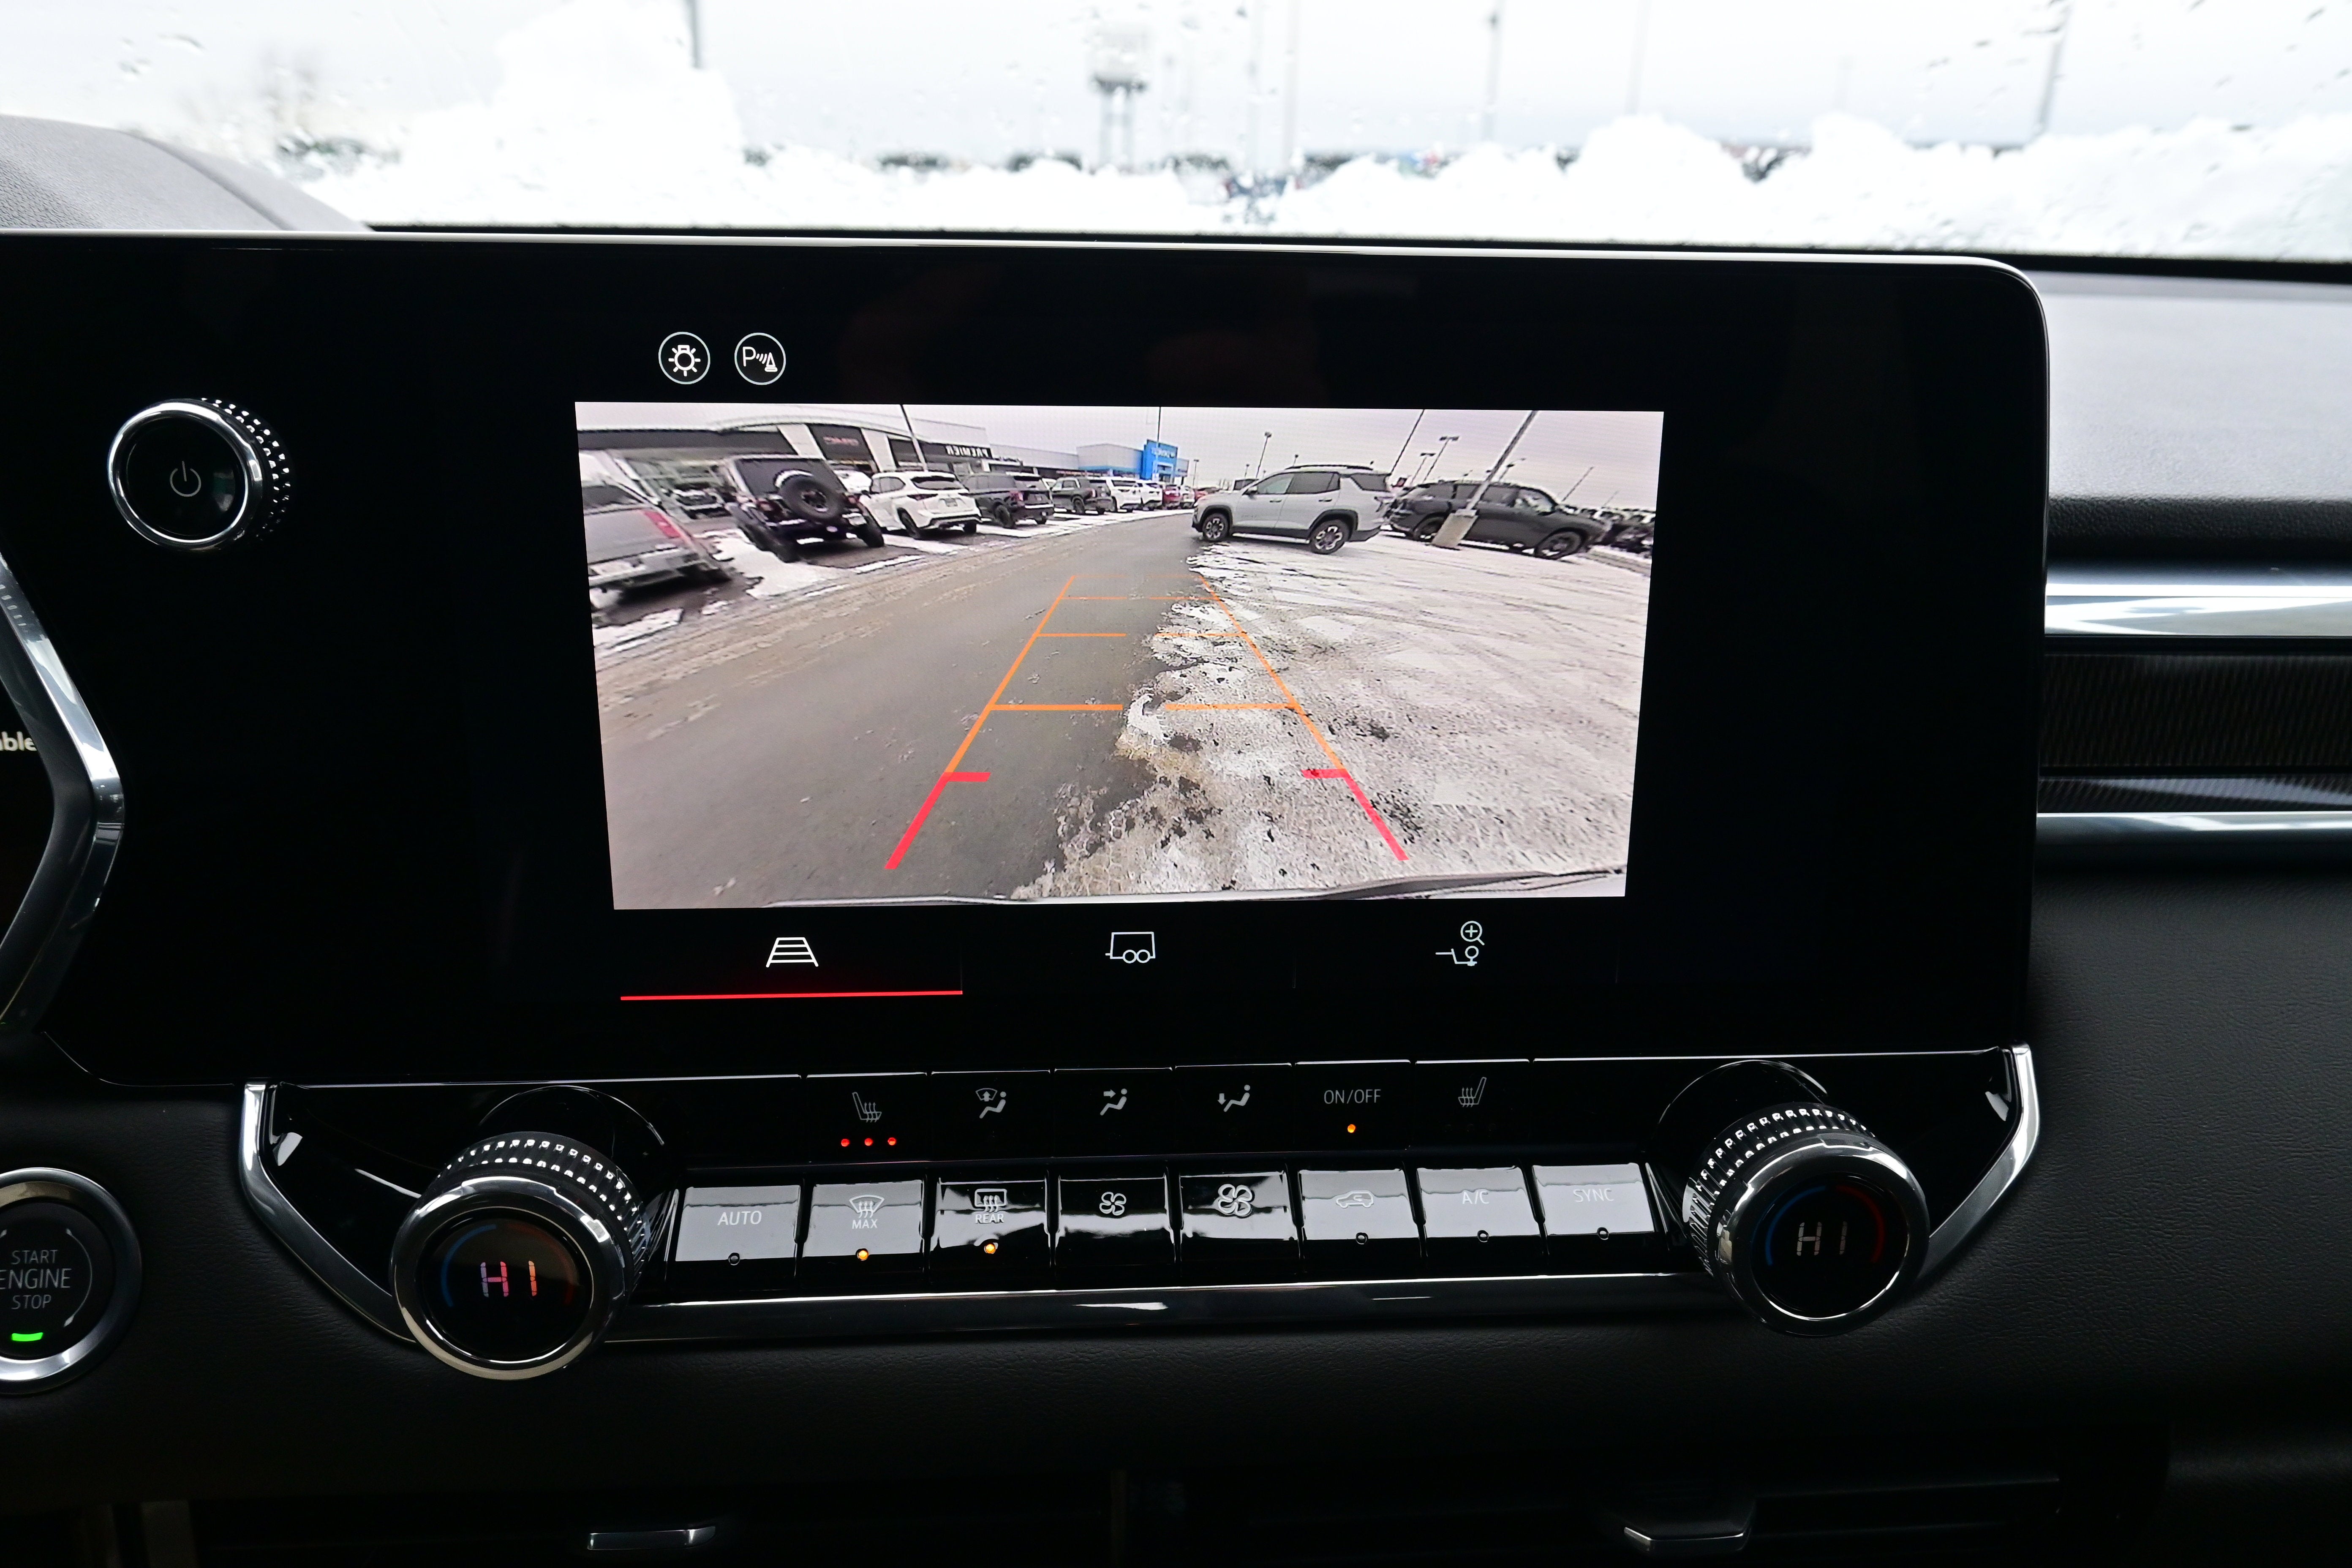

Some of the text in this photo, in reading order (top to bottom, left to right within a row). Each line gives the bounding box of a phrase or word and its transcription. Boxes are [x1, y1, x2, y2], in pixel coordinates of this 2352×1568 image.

[743, 346, 757, 367] P
[1323, 1089, 1381, 1105] ON/OFF
[1462, 1191, 1489, 1204] A/C
[1573, 1188, 1614, 1202] SYNC
[717, 1210, 762, 1225] AUTO
[852, 1219, 878, 1229] MAX
[975, 1213, 1004, 1224] REAR
[1797, 1221, 1848, 1256] HI
[11, 1249, 58, 1265] START
[0, 1268, 72, 1290] ENGINE
[480, 1260, 537, 1297] HI
[12, 1294, 52, 1310] STOP
